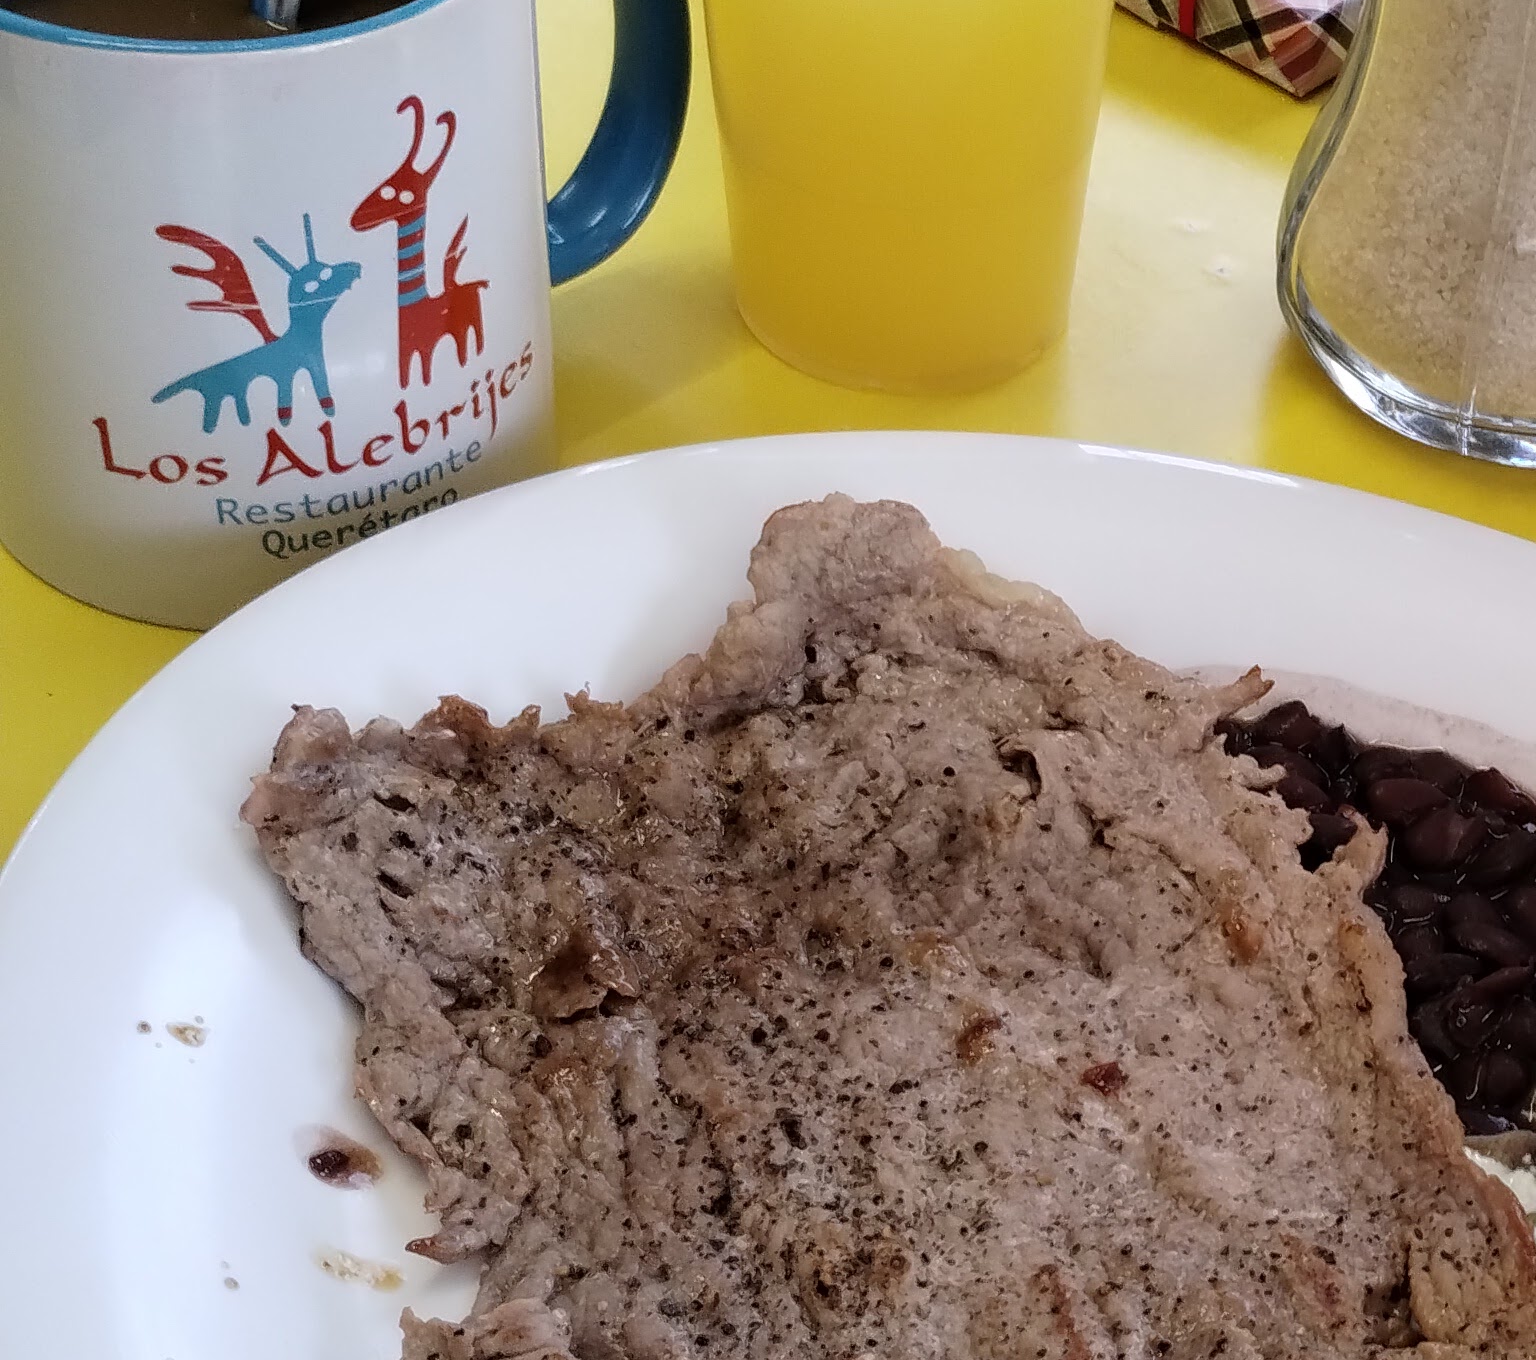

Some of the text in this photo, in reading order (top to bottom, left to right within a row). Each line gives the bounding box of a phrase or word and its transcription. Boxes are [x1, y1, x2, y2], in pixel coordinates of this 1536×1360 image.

[92, 339, 534, 487] Los Alebrijes
[214, 437, 483, 526] Restaurante
